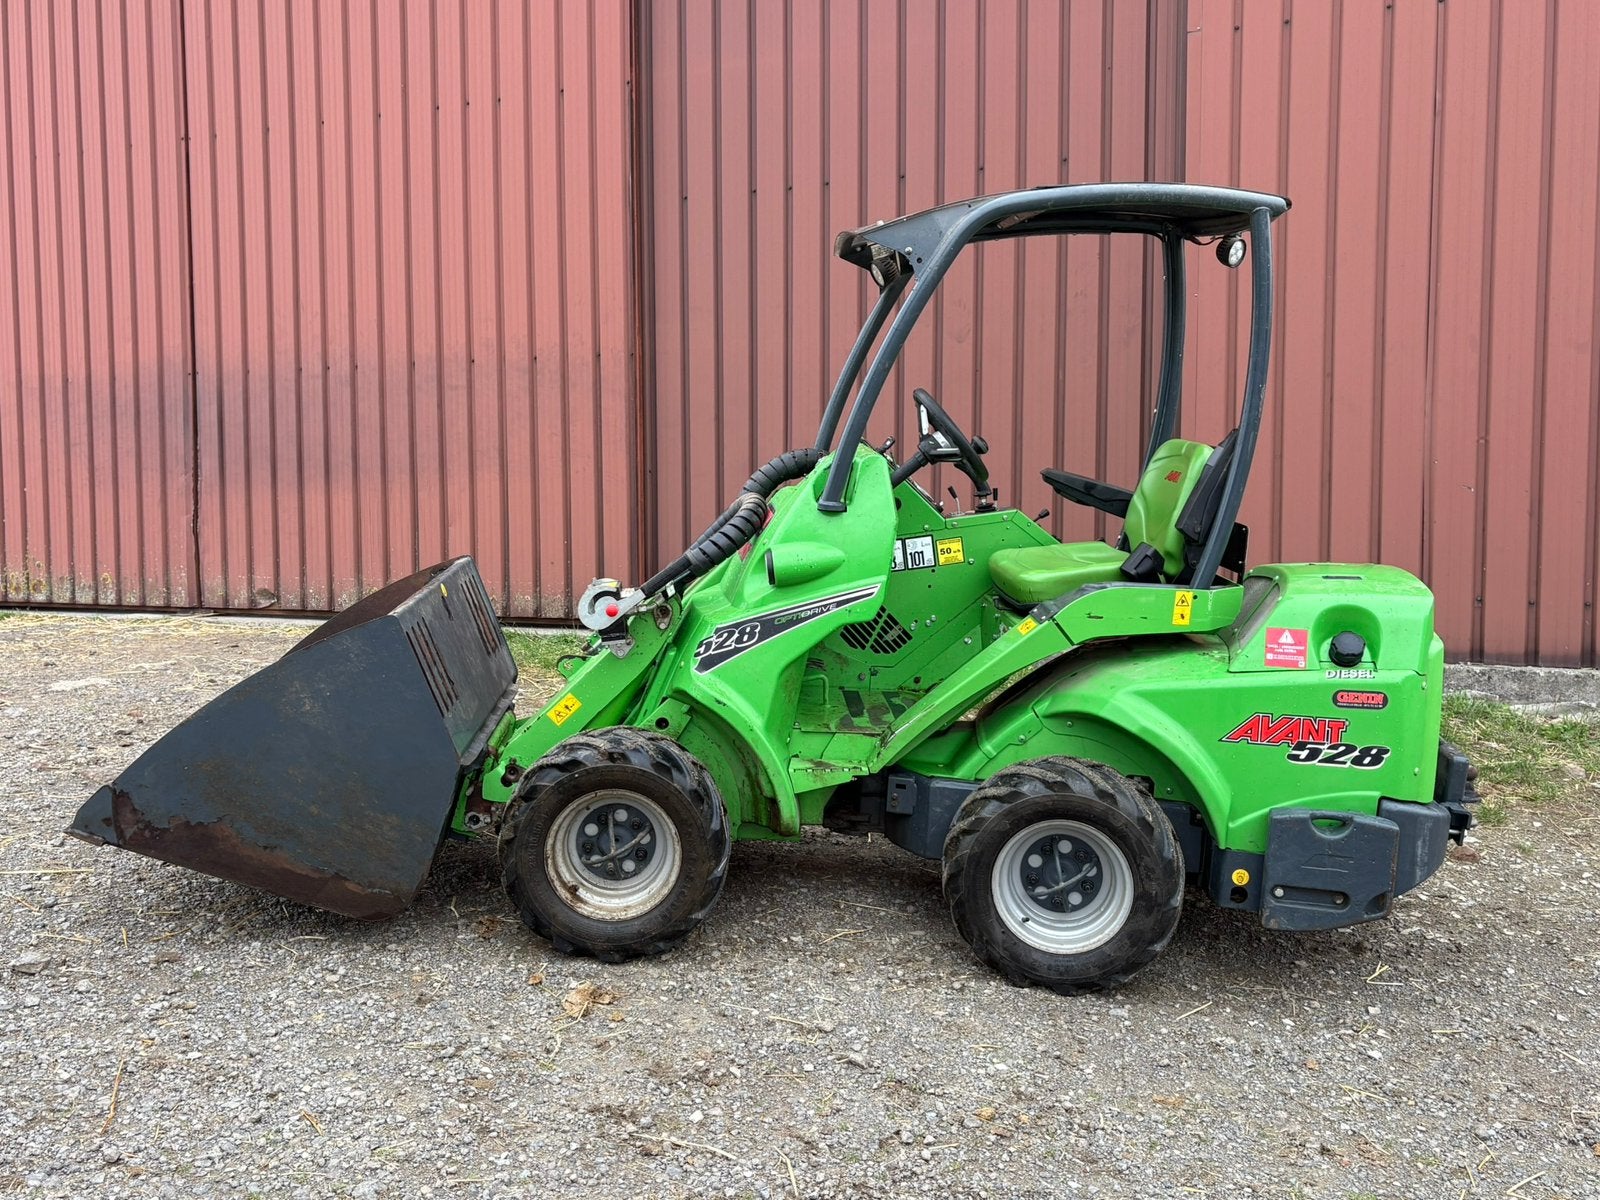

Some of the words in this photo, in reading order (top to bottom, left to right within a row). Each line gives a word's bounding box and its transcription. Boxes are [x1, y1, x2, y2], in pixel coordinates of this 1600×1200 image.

[909, 550, 925, 567] 101
[940, 547, 951, 555] 50
[694, 622, 760, 658] 528
[1326, 669, 1375, 679] DIESEL
[1222, 713, 1348, 746] AVANT
[1286, 741, 1390, 769] 528
